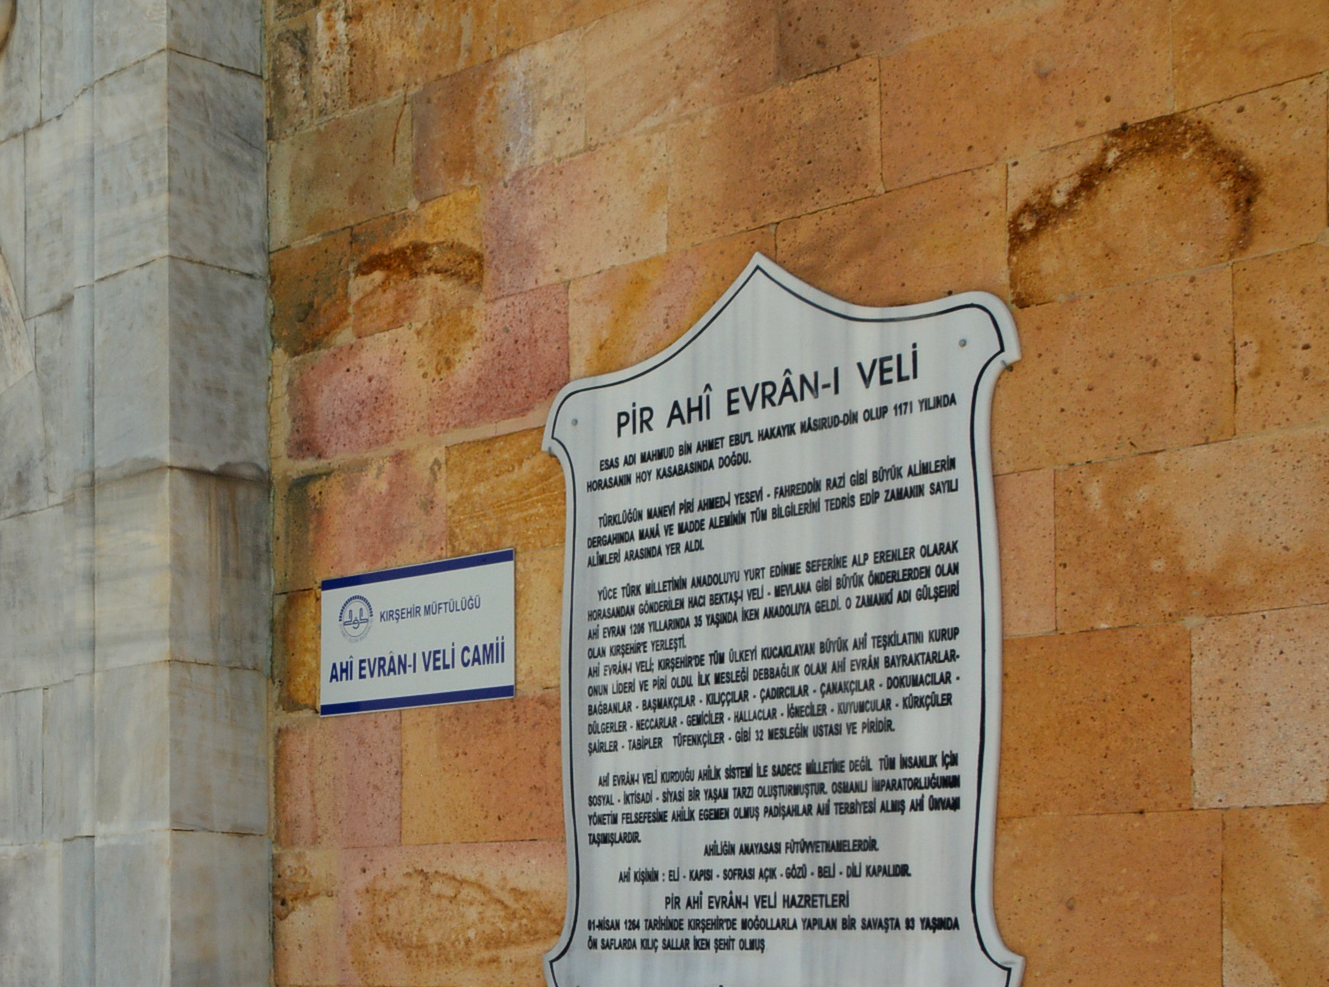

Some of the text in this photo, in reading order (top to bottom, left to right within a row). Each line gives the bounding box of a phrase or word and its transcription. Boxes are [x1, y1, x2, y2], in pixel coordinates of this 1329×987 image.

[617, 342, 917, 437] PİR AHÎ EVRÂN-I VELİ
[600, 393, 956, 471] ESAS ADI MAHMUD BİN AHMET HAKAYIK OLUP 1171 YILINDA
[587, 451, 751, 492] HORASANIN HOY KASABASINDA DOĞDU.
[647, 464, 902, 519] MANEVİ PİRİ YESEVİ FAHREDDİN RAZİ GİBİ BÜYÜK
[587, 531, 634, 548] DERGAHINDA
[664, 524, 673, 536] VE
[678, 519, 705, 534] MADDE
[750, 507, 767, 522] TÜM
[772, 498, 820, 519] BİLGİLERİNİ
[825, 493, 855, 511] TEDRİS
[860, 489, 879, 506] EDİP
[930, 478, 958, 495] SAYILI
[624, 542, 680, 561] ARASINDA YER
[598, 540, 958, 600] YÜCE TÜRK MİLLETİNİN ANADOLUYU YURT EDİNME SEFERİNE ALP ERENLER OLARAK
[380, 594, 481, 623] KIRŞEHİR MÜFTÜLÜĞÜ
[588, 605, 634, 621] HORASANDAN
[688, 595, 705, 608] HACI
[747, 585, 763, 600] VELİ
[774, 582, 811, 597] MEVLANA
[816, 576, 831, 592] GİBİ
[836, 572, 863, 589] BÜYÜK
[935, 562, 958, 577] OLAN
[603, 625, 625, 638] EVRAN
[630, 623, 644, 634] 1206
[648, 617, 690, 632] YILLARINDA
[694, 615, 702, 627] 35
[706, 611, 738, 628] YAŞINDA
[742, 607, 759, 621] İKEN
[763, 602, 811, 619] ANADOLUYA
[845, 597, 851, 609] O
[896, 590, 911, 603] ADI
[330, 635, 505, 683] AHÎ EVRÂN-I VELİ CAMİİ
[588, 647, 605, 659] OLAN
[708, 627, 959, 665] TÜM ÜLKEYİ KUCAKLAYAN BÜYÜK AHÎ TEŞKİLATINI KURUP
[588, 662, 826, 696] ONUN LİDERİ VE PİRİ İLK MESLEĞİ DEBBAĞLIK OLAN
[588, 701, 631, 716] BAĞBANLAR
[642, 695, 695, 712] BAŞMAKÇILAR
[760, 685, 808, 703] ÇADIRCILAR
[820, 678, 874, 698] ÇANAKÇILAR
[887, 671, 951, 689] DOKUMACILAR
[588, 721, 627, 734] DÜLGERLER
[636, 716, 676, 730] NECCARLAR
[838, 698, 891, 714] KUYUMCULAR
[902, 691, 952, 710] KÜRKÇÜLER
[588, 722, 856, 756] ŞAİRLER TABİPLER TÜFENKÇİLER GİBİ 32 MESLEĞİN USTASI VE
[661, 767, 694, 782] KURDUĞU
[757, 763, 768, 777] İLE
[772, 763, 801, 776] SADECE
[879, 755, 895, 770] TÜM
[588, 795, 614, 806] SOSYAL
[624, 790, 652, 804] İKTİSADİ
[688, 787, 699, 800] BİR
[704, 788, 728, 802] YAŞAM
[733, 786, 753, 798] TARZI
[733, 806, 759, 821] OLMUŞ
[669, 867, 679, 881] ELİ
[723, 868, 754, 880] SOFRASI
[818, 863, 835, 878] BELİ
[665, 890, 849, 909] PİR AHÎ EVRÂN-I VELİ HAZRETLERİ
[802, 918, 837, 930] YAPILAN
[842, 915, 856, 930] BİR
[861, 917, 900, 933] SAVAŞTA
[588, 936, 765, 953] ÖN SAFLARDA KILIÇ SALLAR İKEN ŞEHİT OLMUŞ
